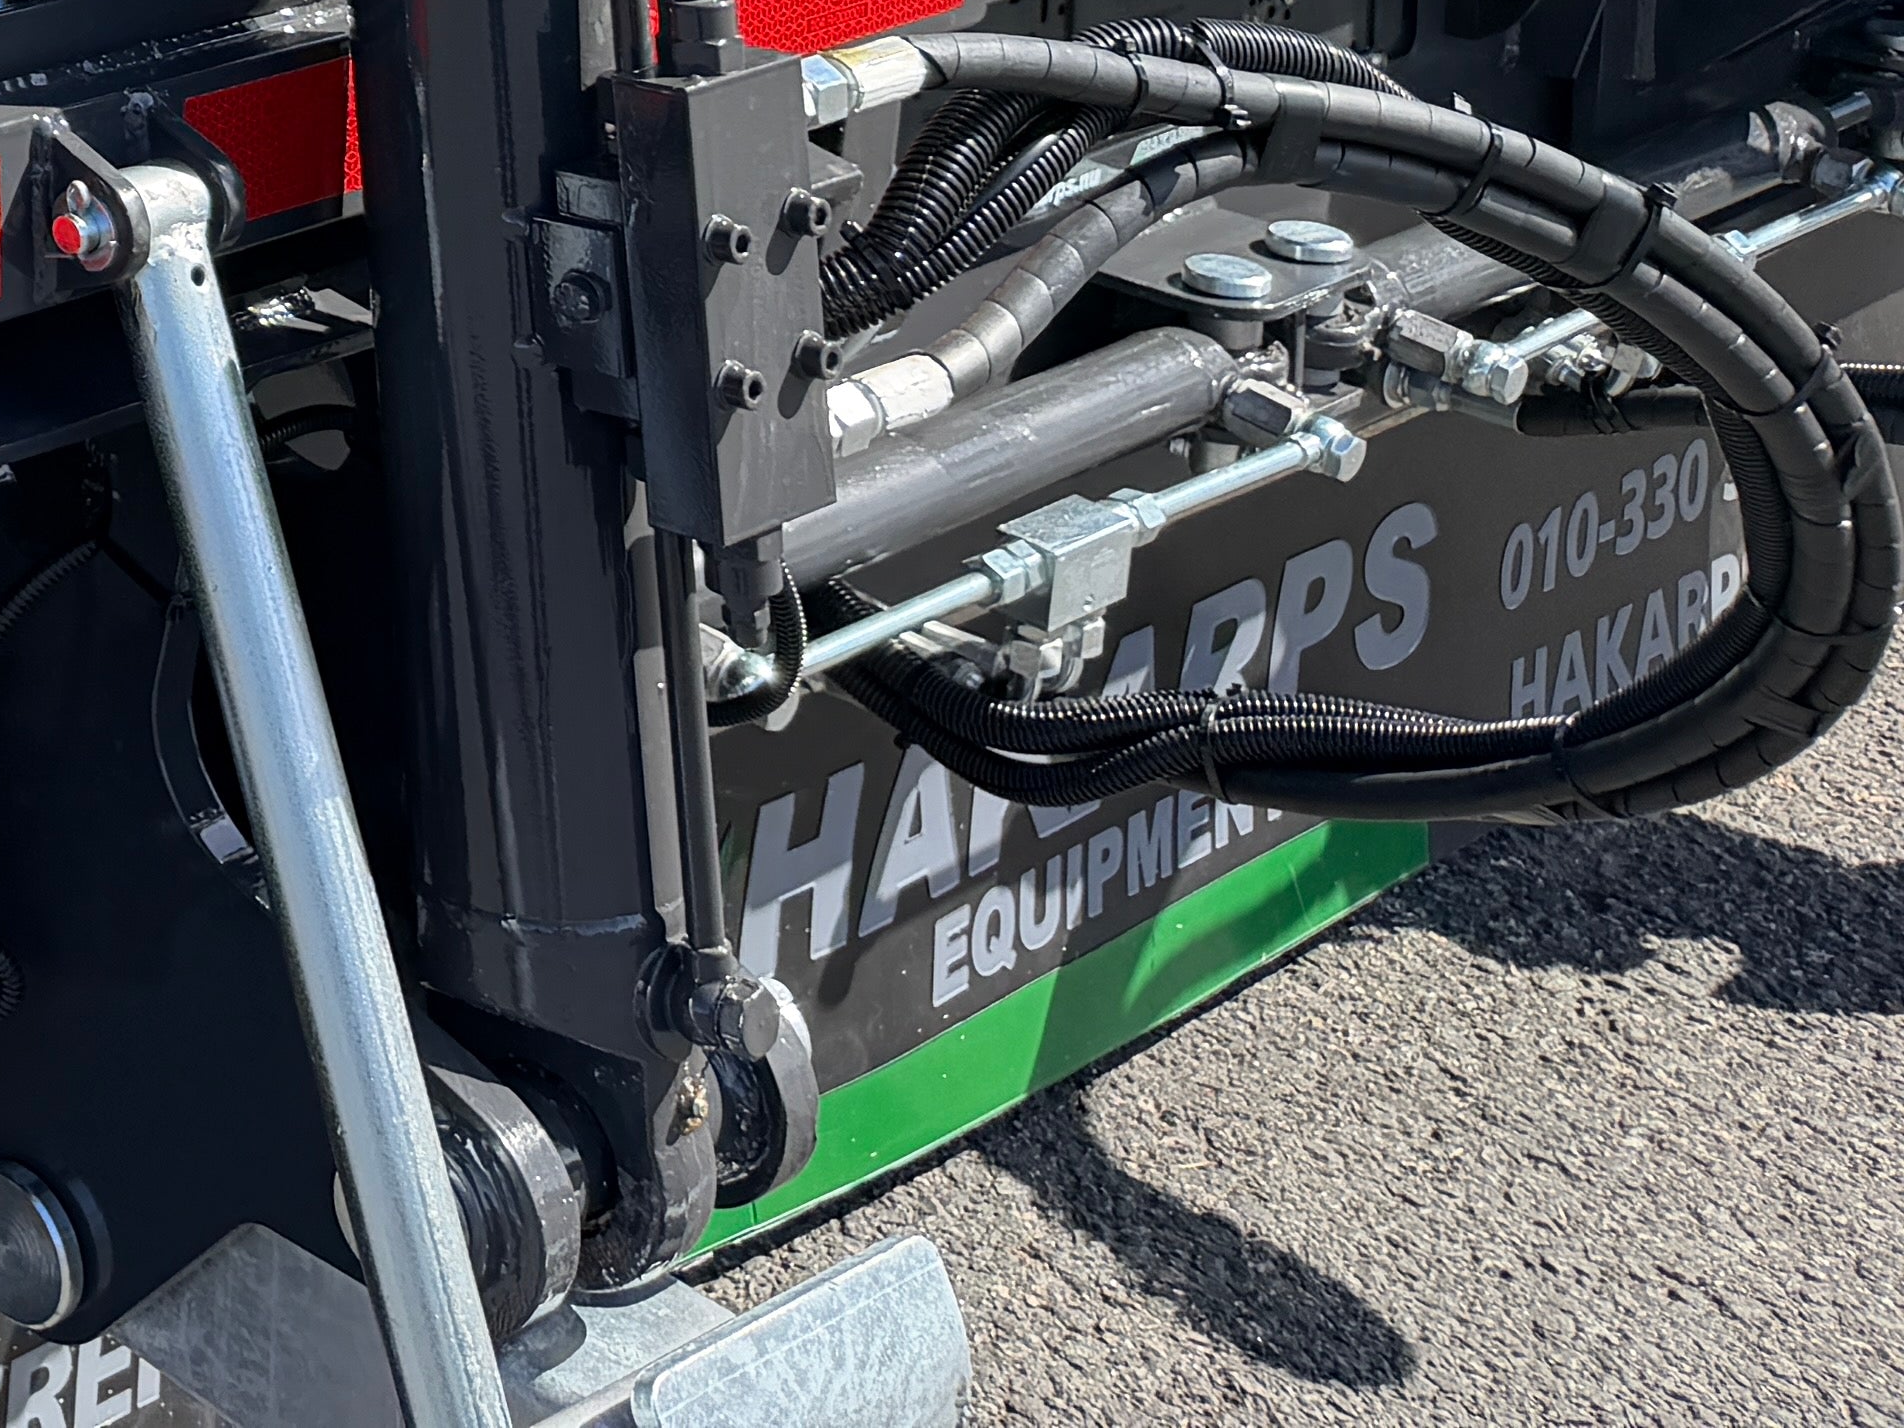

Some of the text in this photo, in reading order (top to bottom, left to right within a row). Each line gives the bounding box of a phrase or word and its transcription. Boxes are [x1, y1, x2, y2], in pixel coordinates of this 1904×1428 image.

[1500, 437, 1710, 611] 010-330
[1510, 552, 1748, 721] HAKARP
[932, 787, 1283, 1008] EQUIPMEN
